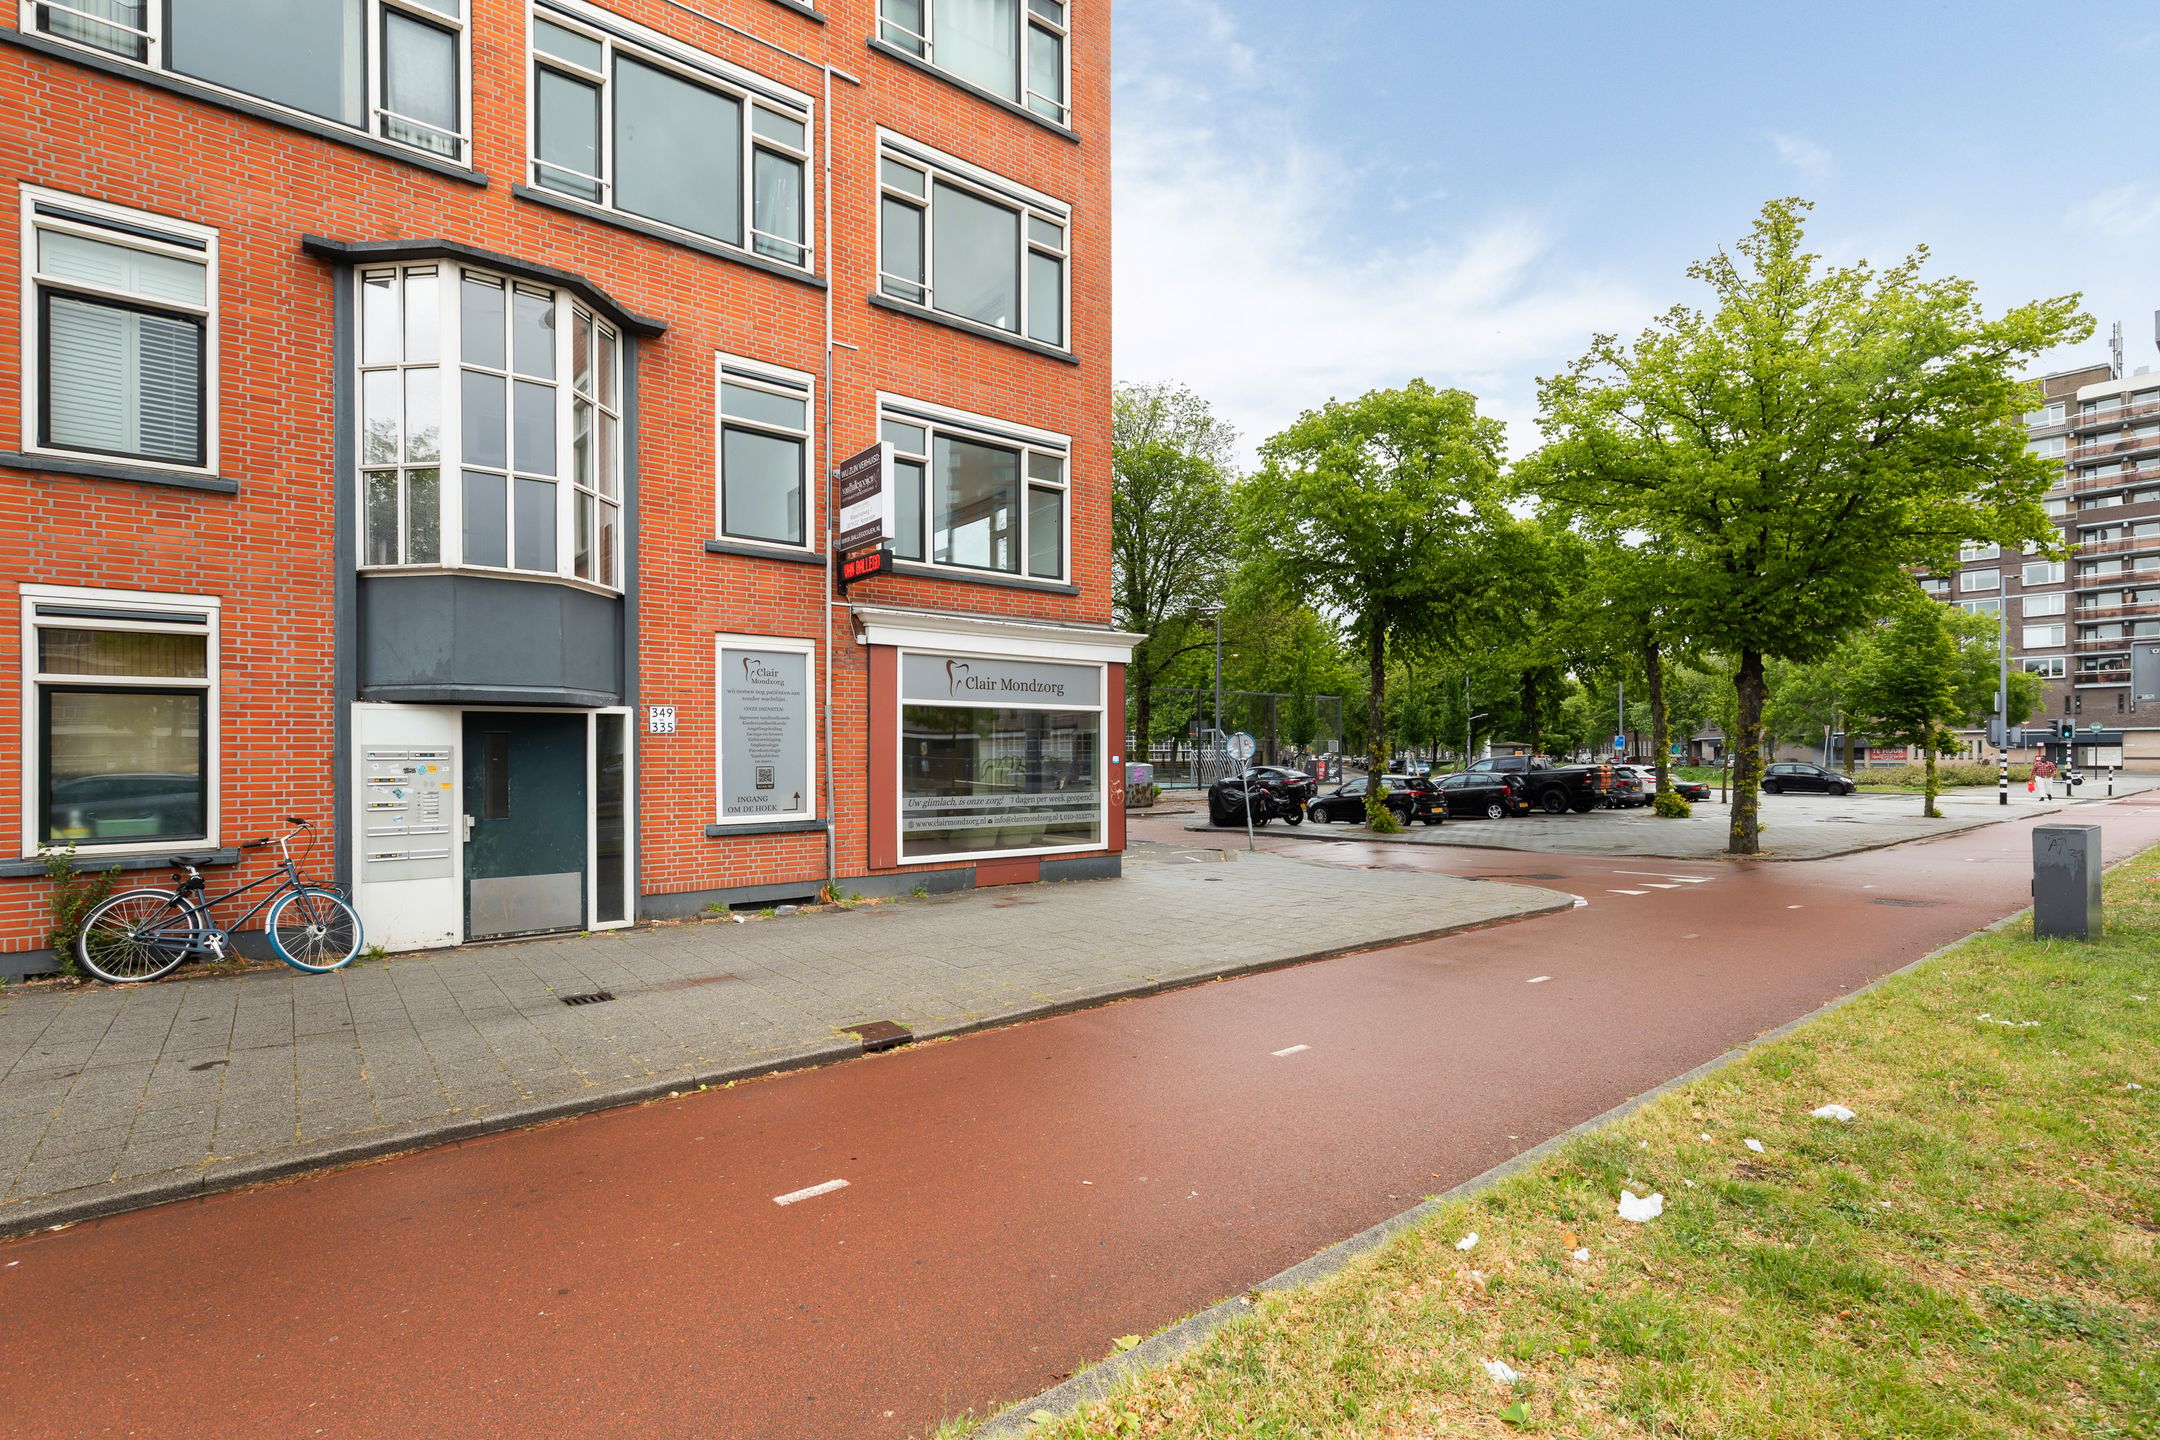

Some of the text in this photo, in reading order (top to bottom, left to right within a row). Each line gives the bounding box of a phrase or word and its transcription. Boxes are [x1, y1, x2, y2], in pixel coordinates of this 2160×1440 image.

[756, 667, 780, 677] Clair
[751, 678, 785, 687] Mondzorg
[965, 675, 1065, 697] Clair Mondzorg
[651, 707, 673, 718] 349
[651, 722, 674, 733] 335
[737, 795, 769, 803] INGANG
[908, 798, 921, 807] Uw
[921, 797, 957, 809] glimlach,
[958, 797, 966, 806] is
[966, 798, 985, 806] onze
[985, 796, 1005, 806] zorg!
[1015, 795, 1036, 805] dagen
[1036, 796, 1048, 804] per
[1048, 794, 1065, 802] week
[743, 805, 754, 813] DE
[755, 804, 778, 812] HOEK
[915, 817, 987, 827] www.clairmondzorg.nl
[994, 813, 1059, 824] info@clairmondzorg.nl
